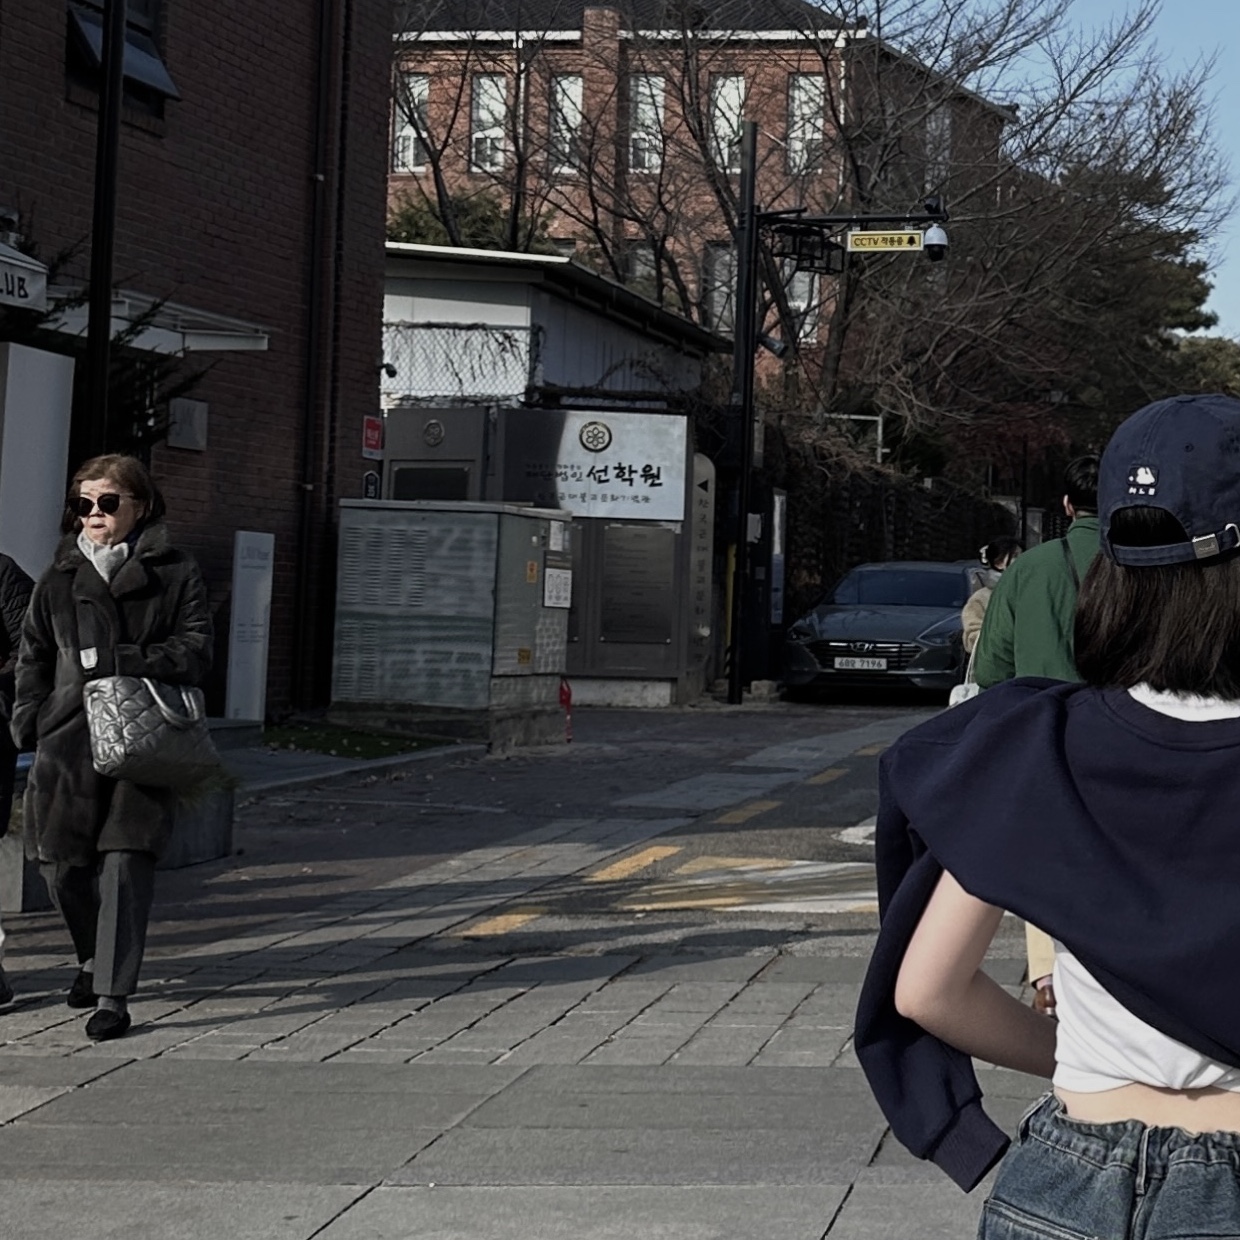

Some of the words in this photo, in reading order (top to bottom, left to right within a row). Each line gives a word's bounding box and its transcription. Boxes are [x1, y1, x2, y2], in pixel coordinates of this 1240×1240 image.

[854, 237, 879, 246] CCTV
[0, 272, 28, 298] UB
[586, 462, 663, 487] 선학원
[1129, 487, 1155, 495] MLB
